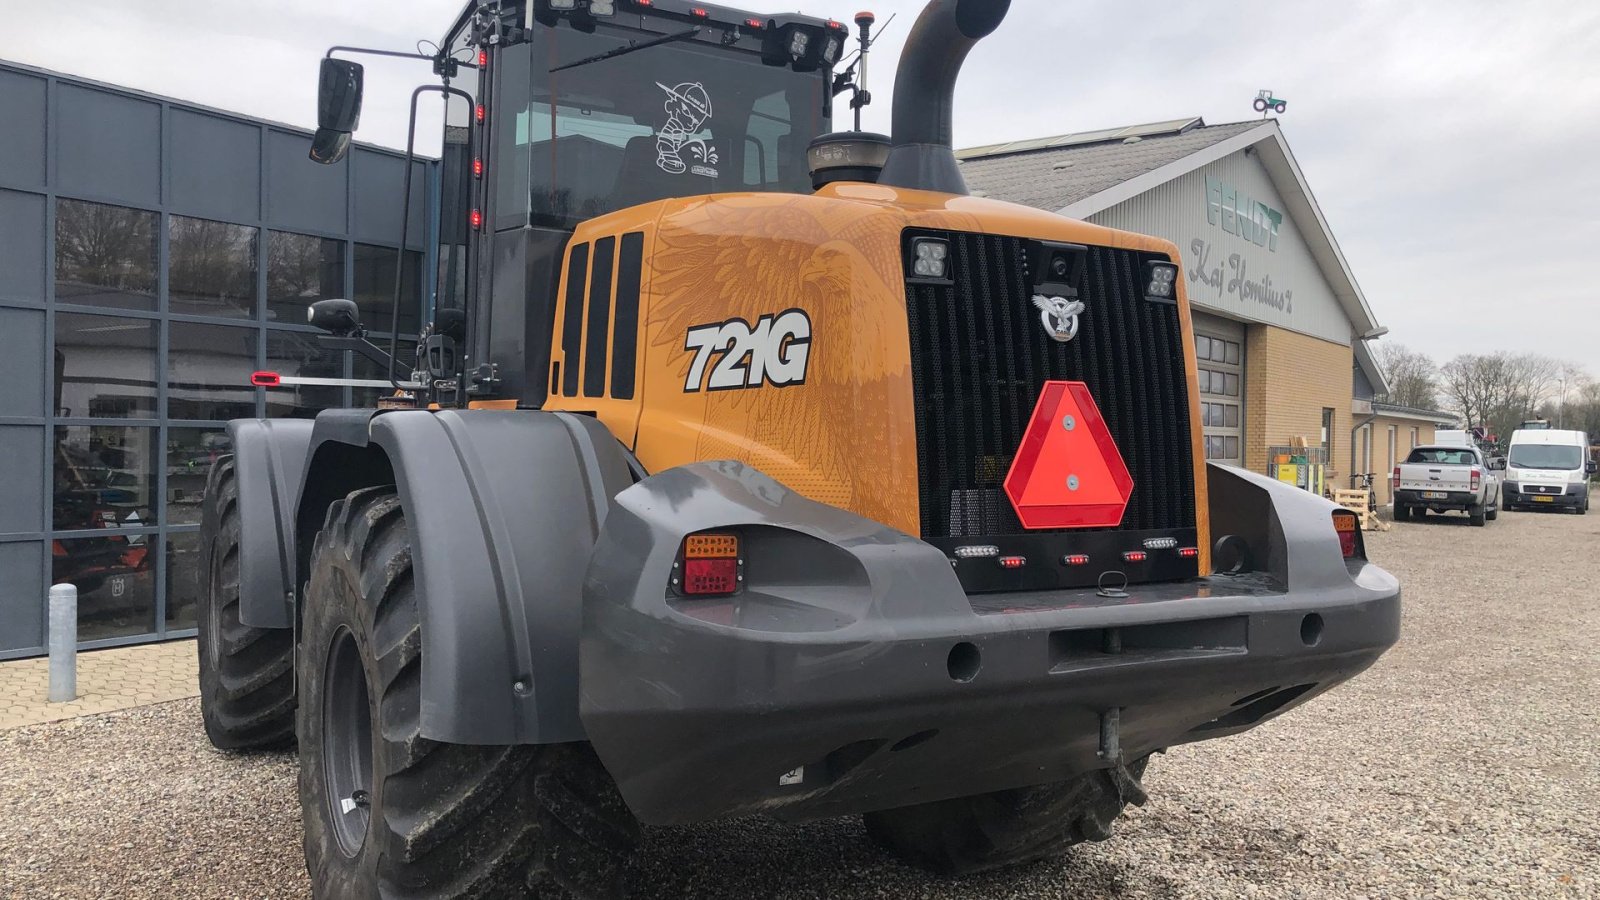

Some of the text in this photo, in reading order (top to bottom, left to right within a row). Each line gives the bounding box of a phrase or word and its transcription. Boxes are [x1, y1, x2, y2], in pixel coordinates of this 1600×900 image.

[1205, 174, 1283, 252] FENDT
[1189, 238, 1225, 298] Kaj
[683, 307, 812, 393] 721G
